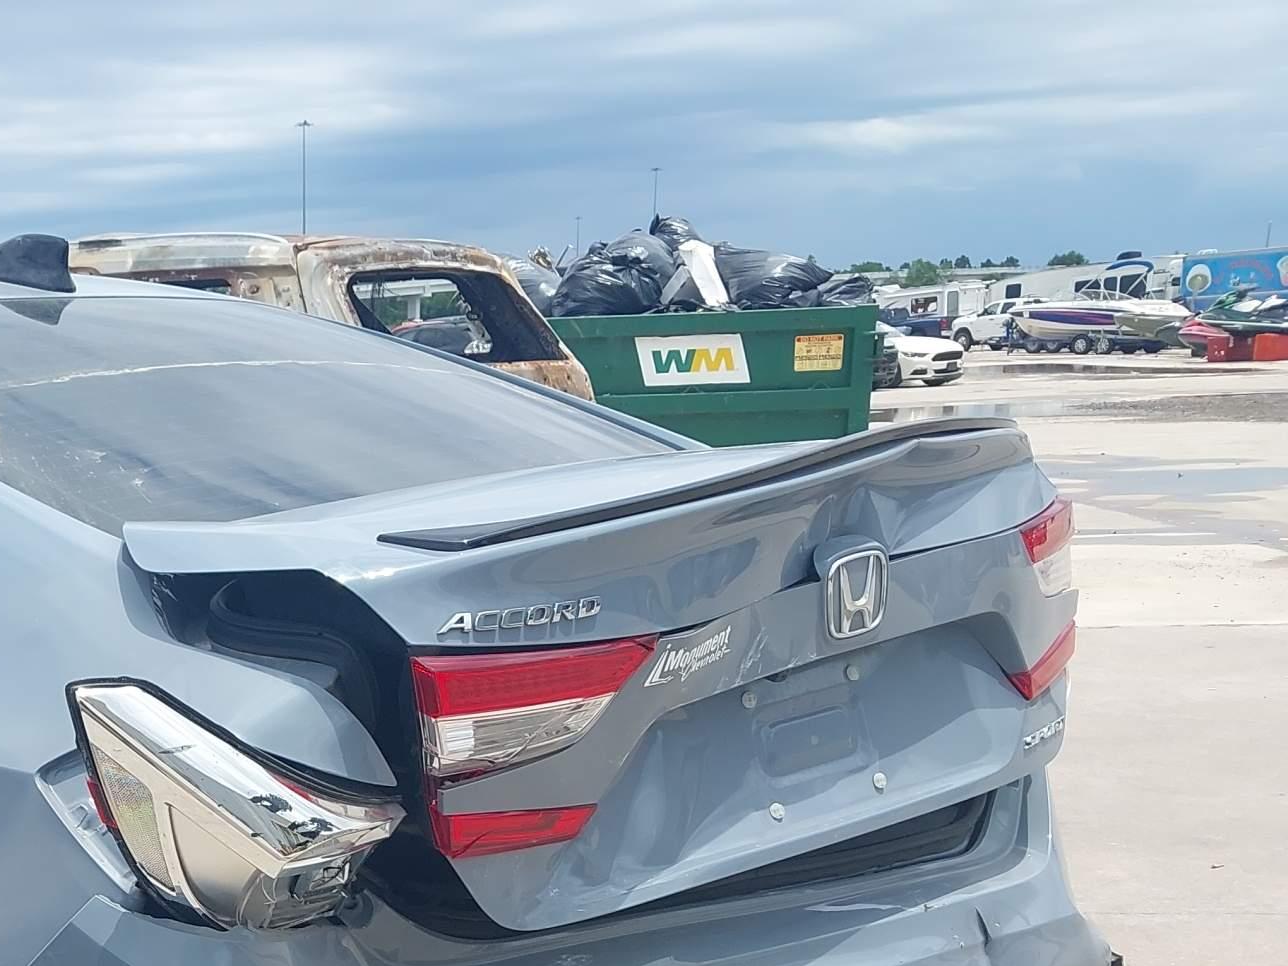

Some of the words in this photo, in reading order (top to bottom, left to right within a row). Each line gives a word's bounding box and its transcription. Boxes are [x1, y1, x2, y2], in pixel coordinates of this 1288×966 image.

[652, 347, 735, 373] WM
[437, 595, 601, 634] ACCORD
[663, 625, 731, 672] Monument
